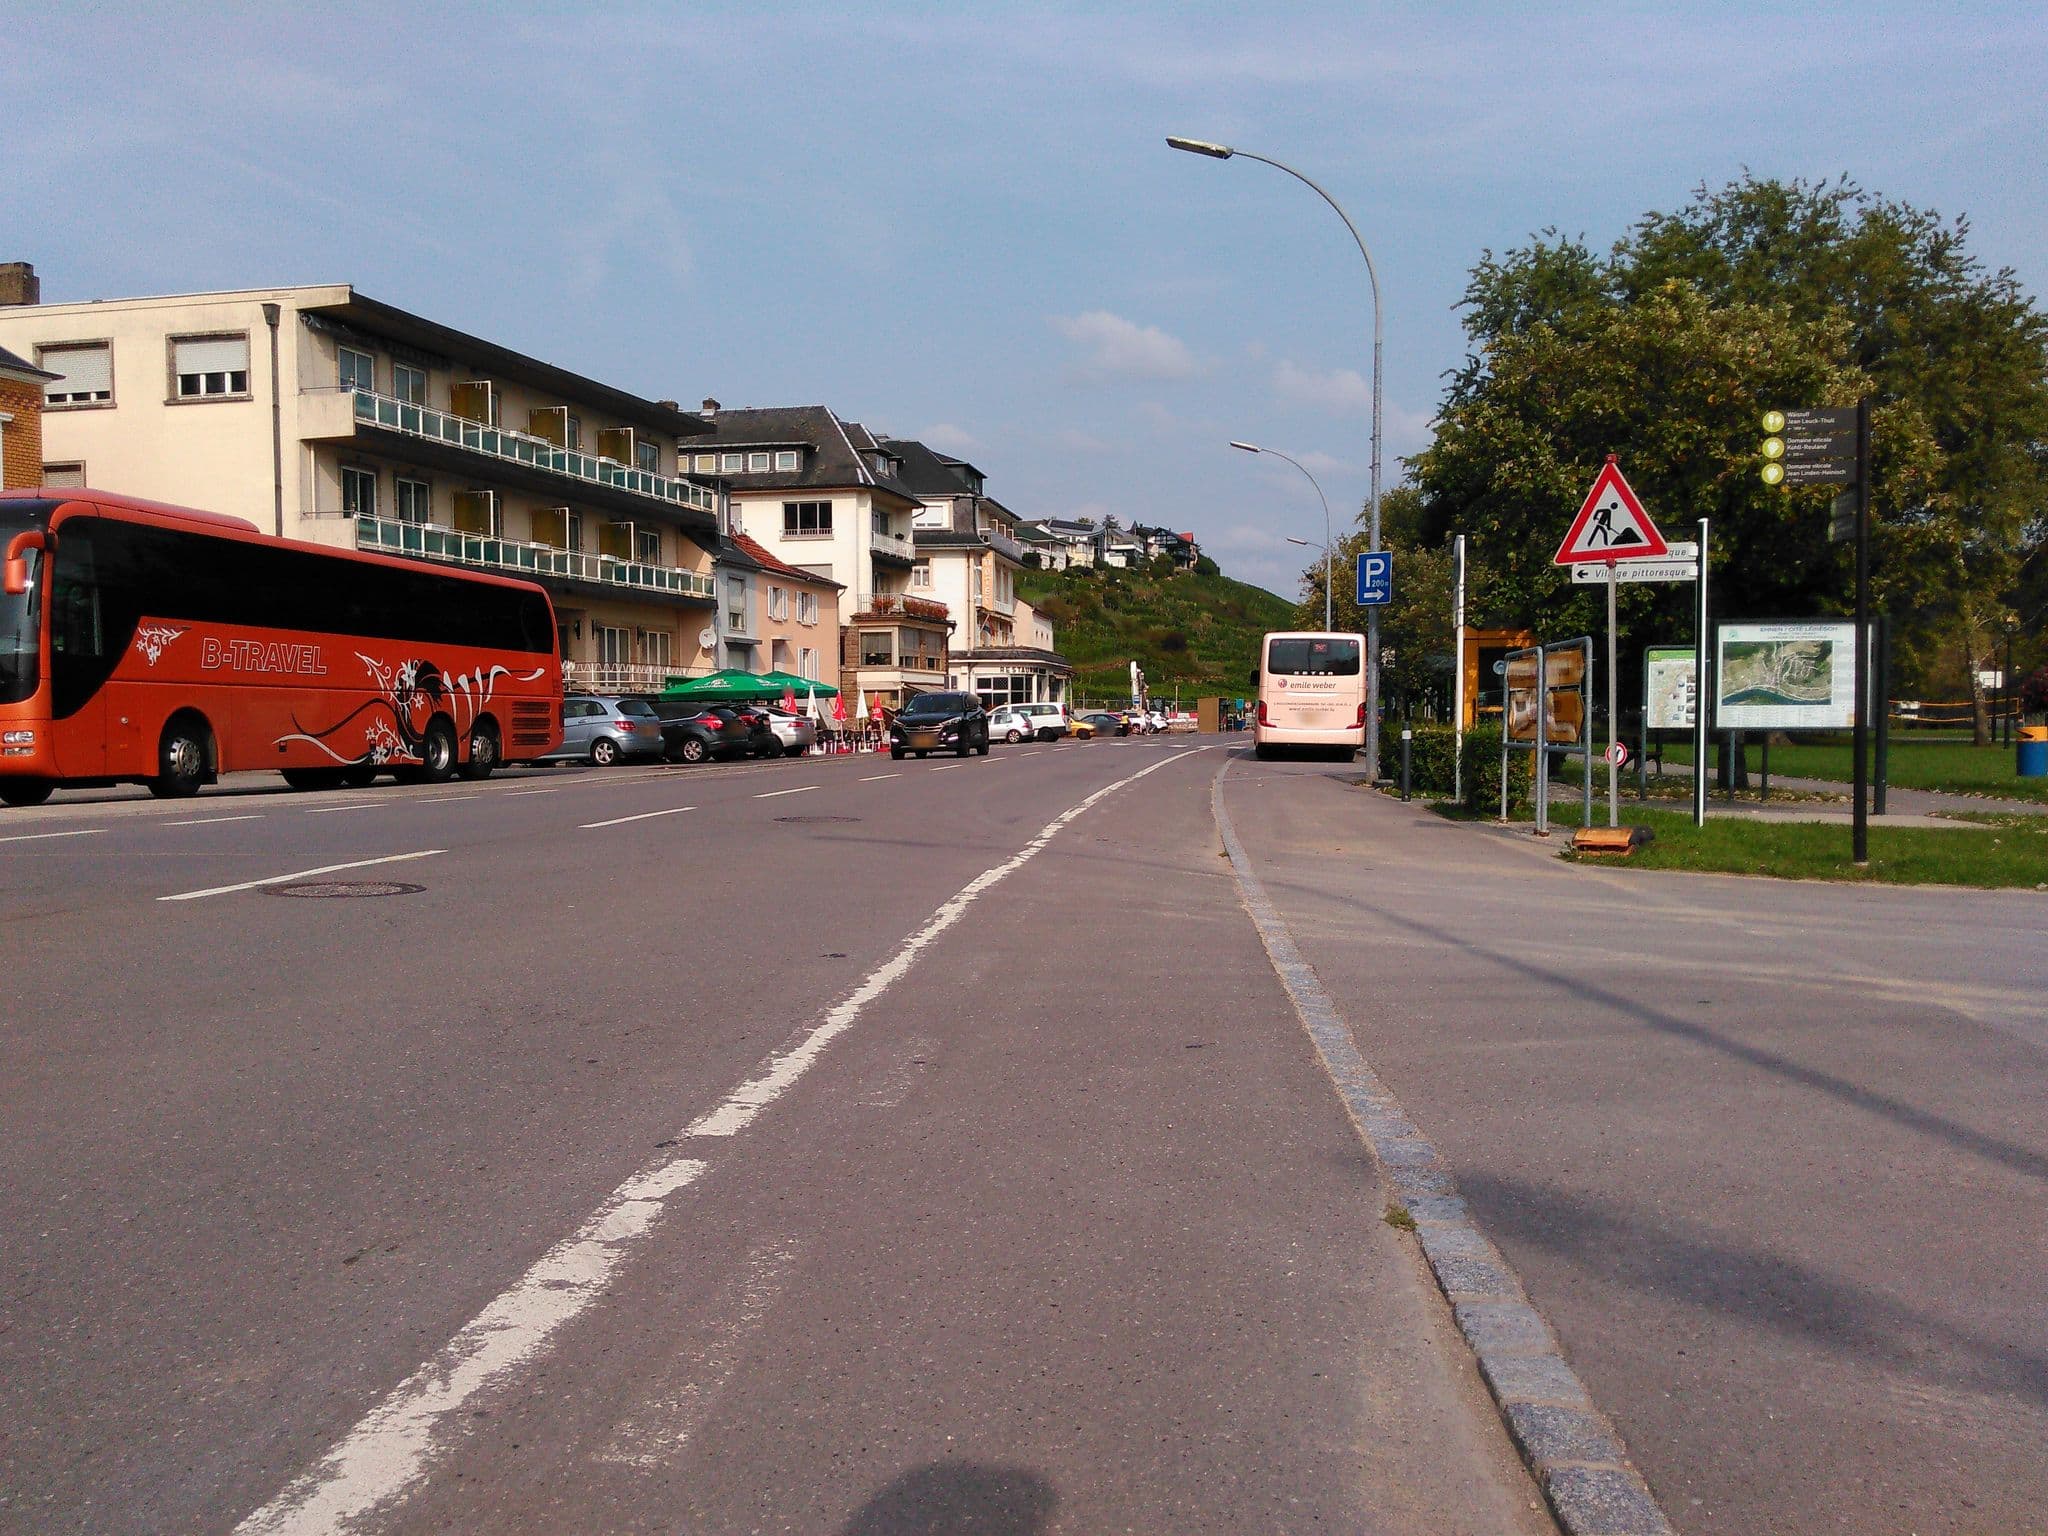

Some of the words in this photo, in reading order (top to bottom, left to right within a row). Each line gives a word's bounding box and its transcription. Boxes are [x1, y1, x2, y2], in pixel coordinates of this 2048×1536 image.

[1366, 559, 1385, 588] P
[1595, 569, 1628, 579] Vilge
[1631, 568, 1687, 579] pittoresque
[201, 637, 327, 675] B-TRAVEL
[1290, 681, 1311, 689] emile
[1312, 681, 1337, 689] weber
